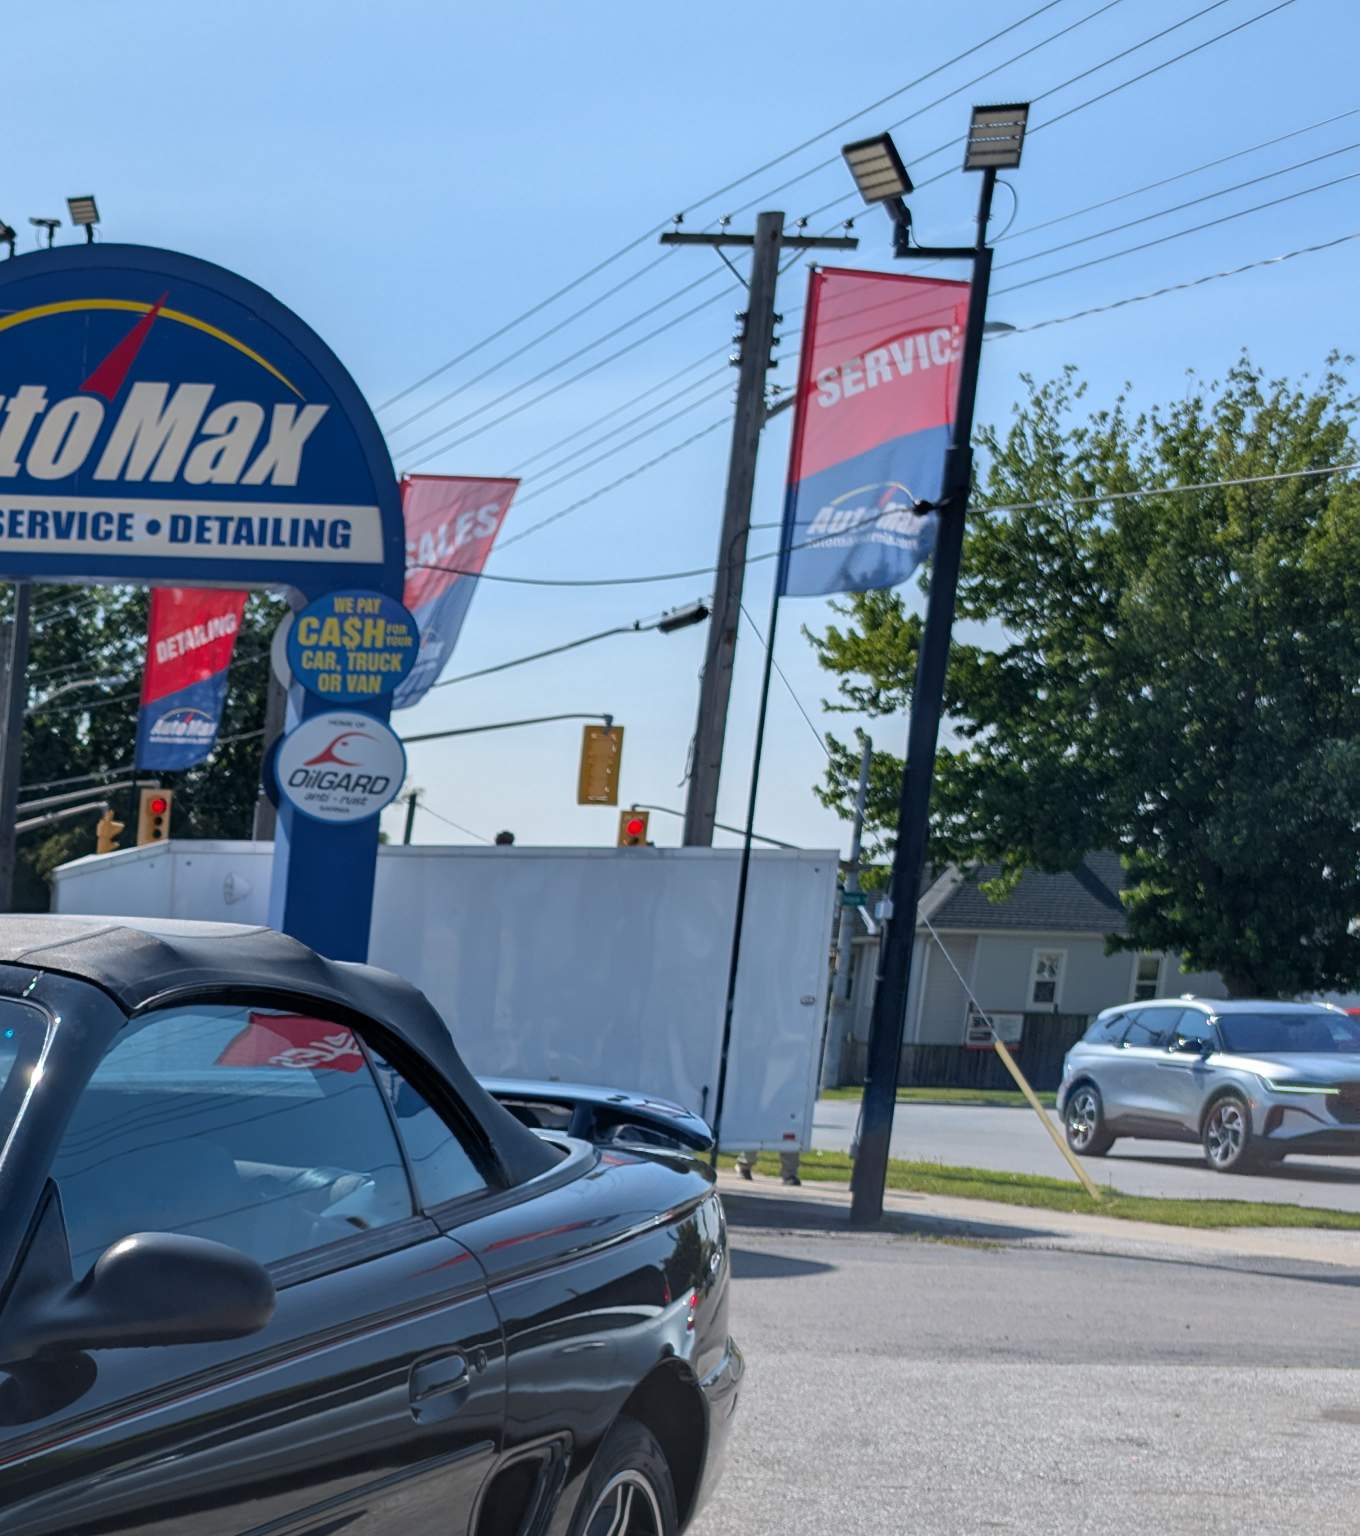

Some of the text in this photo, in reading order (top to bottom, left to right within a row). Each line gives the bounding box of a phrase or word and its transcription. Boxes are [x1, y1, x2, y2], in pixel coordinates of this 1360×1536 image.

[168, 514, 352, 550] DETAILING
[333, 596, 382, 614] WE PAY
[155, 612, 238, 664] DETAILING
[297, 616, 386, 649] CA$H
[301, 651, 403, 673] CAR, TRUCK
[318, 673, 383, 694] OR VAN
[288, 768, 391, 796] OilGARD
